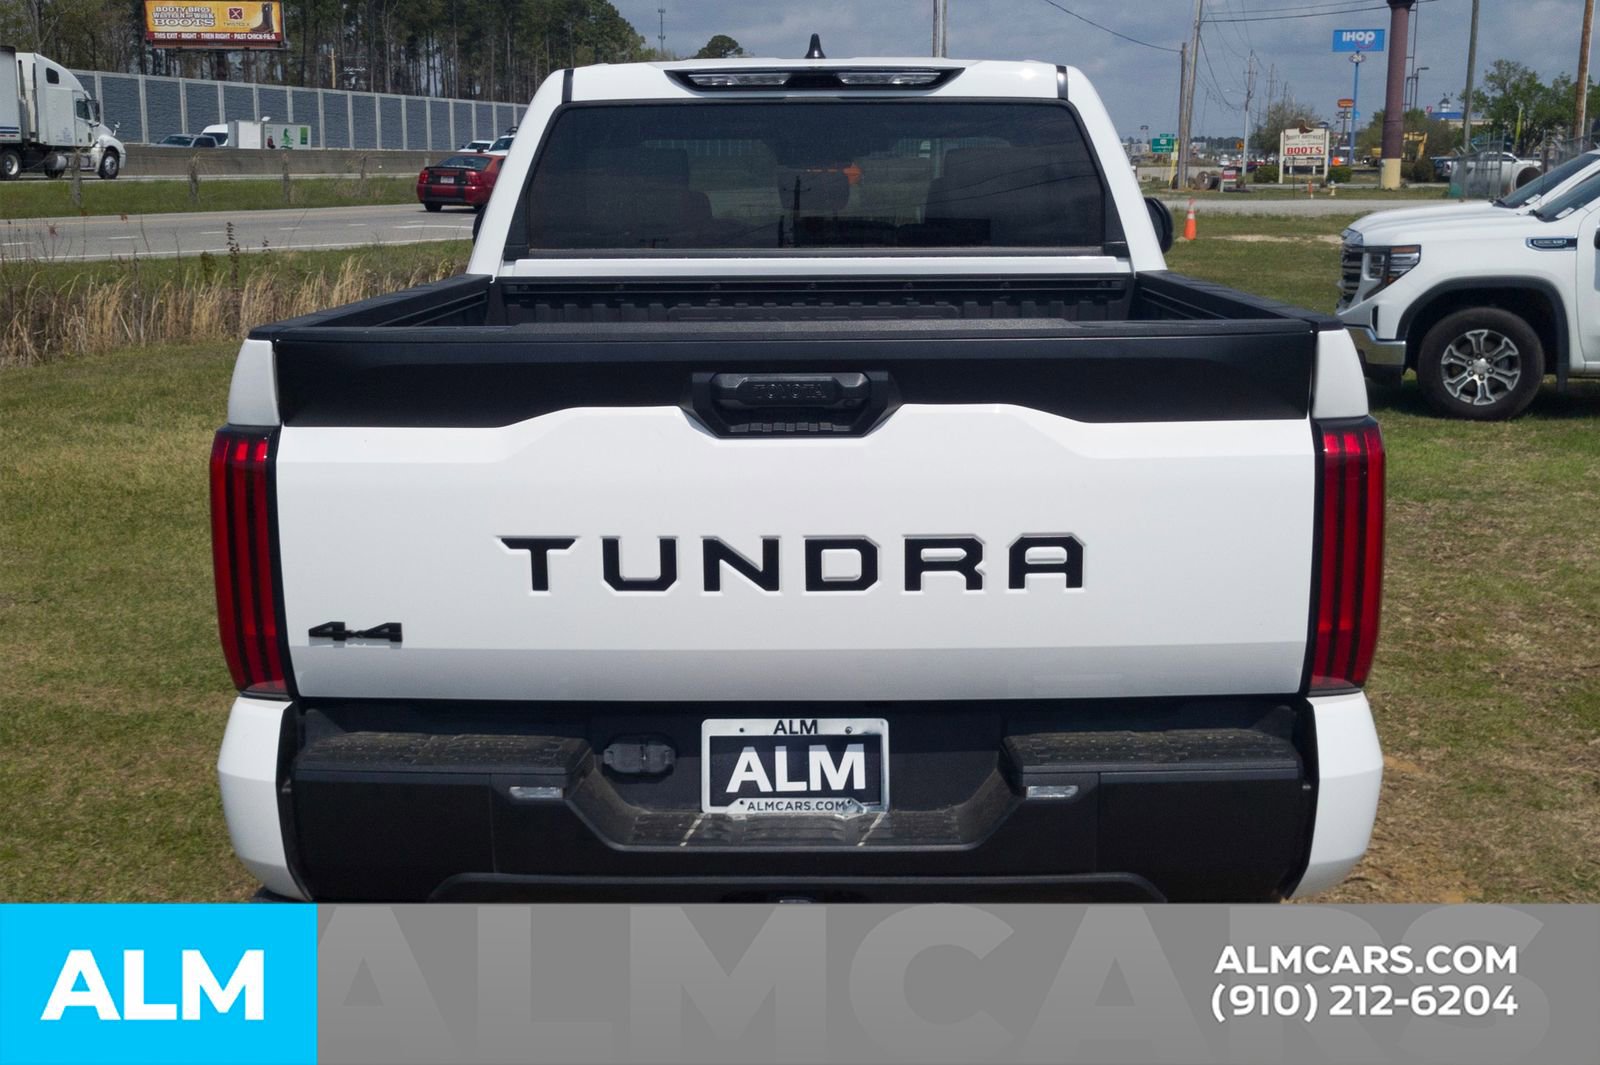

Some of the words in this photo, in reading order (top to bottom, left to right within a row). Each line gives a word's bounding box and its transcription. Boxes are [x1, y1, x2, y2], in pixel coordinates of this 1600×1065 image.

[153, 18, 215, 27] BOOTS
[1286, 146, 1322, 155] BOOTS
[752, 383, 827, 399] TOYOTA
[497, 533, 1085, 593] TUNDRA
[773, 719, 818, 735] ALM
[725, 743, 866, 793] ALM
[746, 800, 845, 812] ALMCARS.COM
